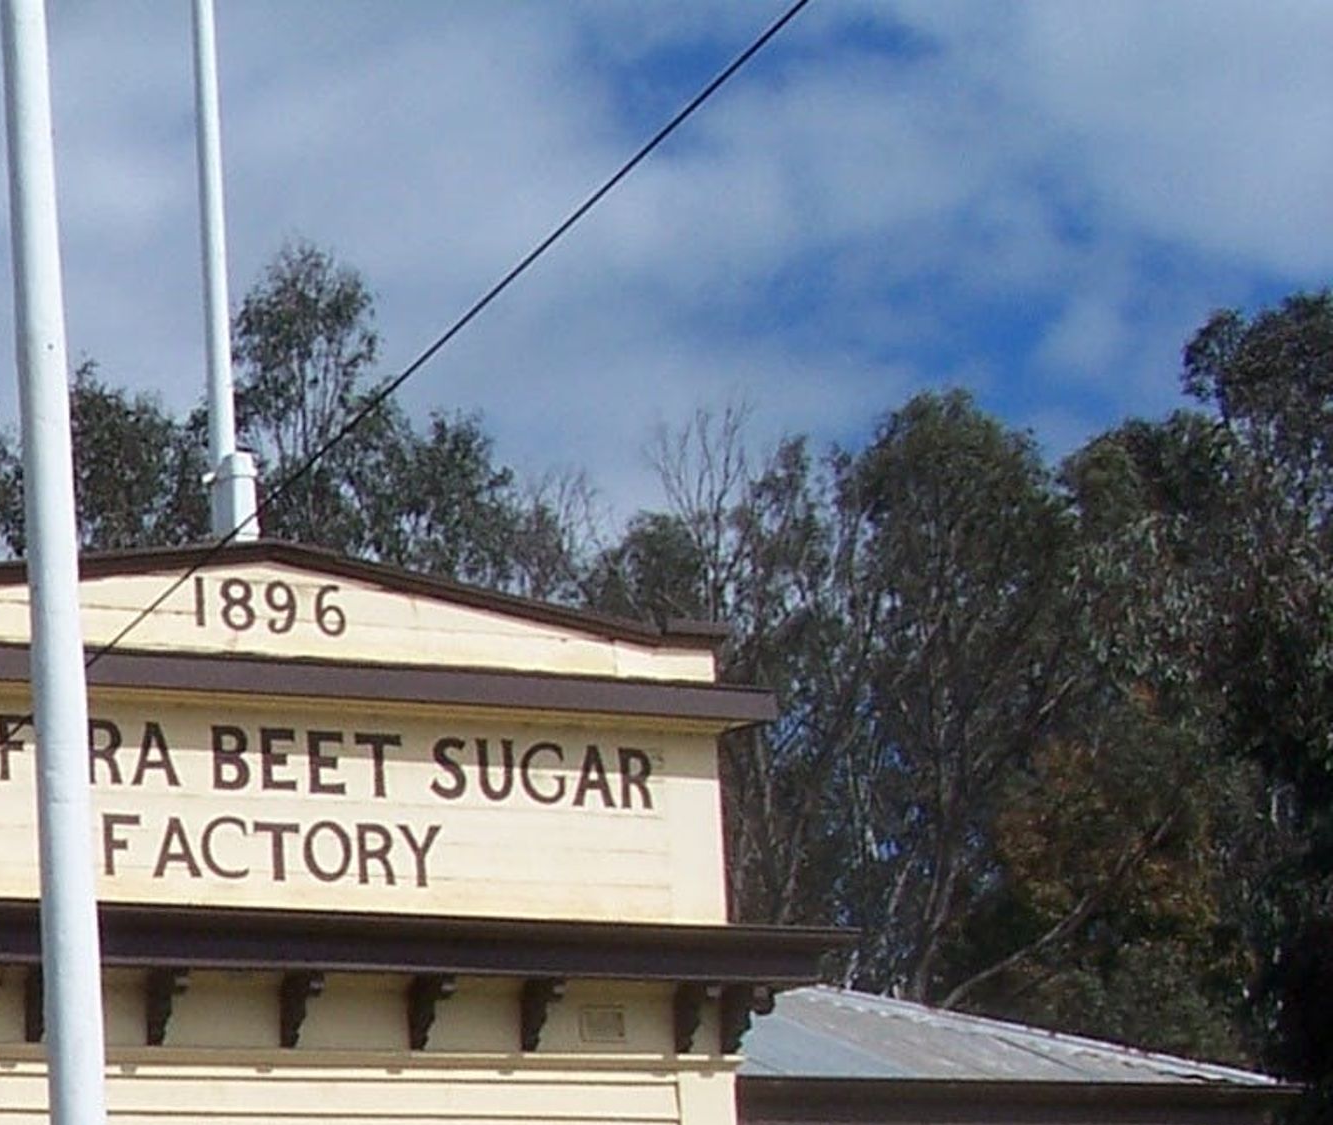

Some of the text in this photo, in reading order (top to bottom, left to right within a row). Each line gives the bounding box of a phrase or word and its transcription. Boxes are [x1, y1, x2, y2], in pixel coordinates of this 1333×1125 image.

[194, 576, 347, 637] 1896
[211, 724, 401, 799] BEET
[432, 737, 653, 810] SUGAR
[103, 814, 441, 888] FACTORY
